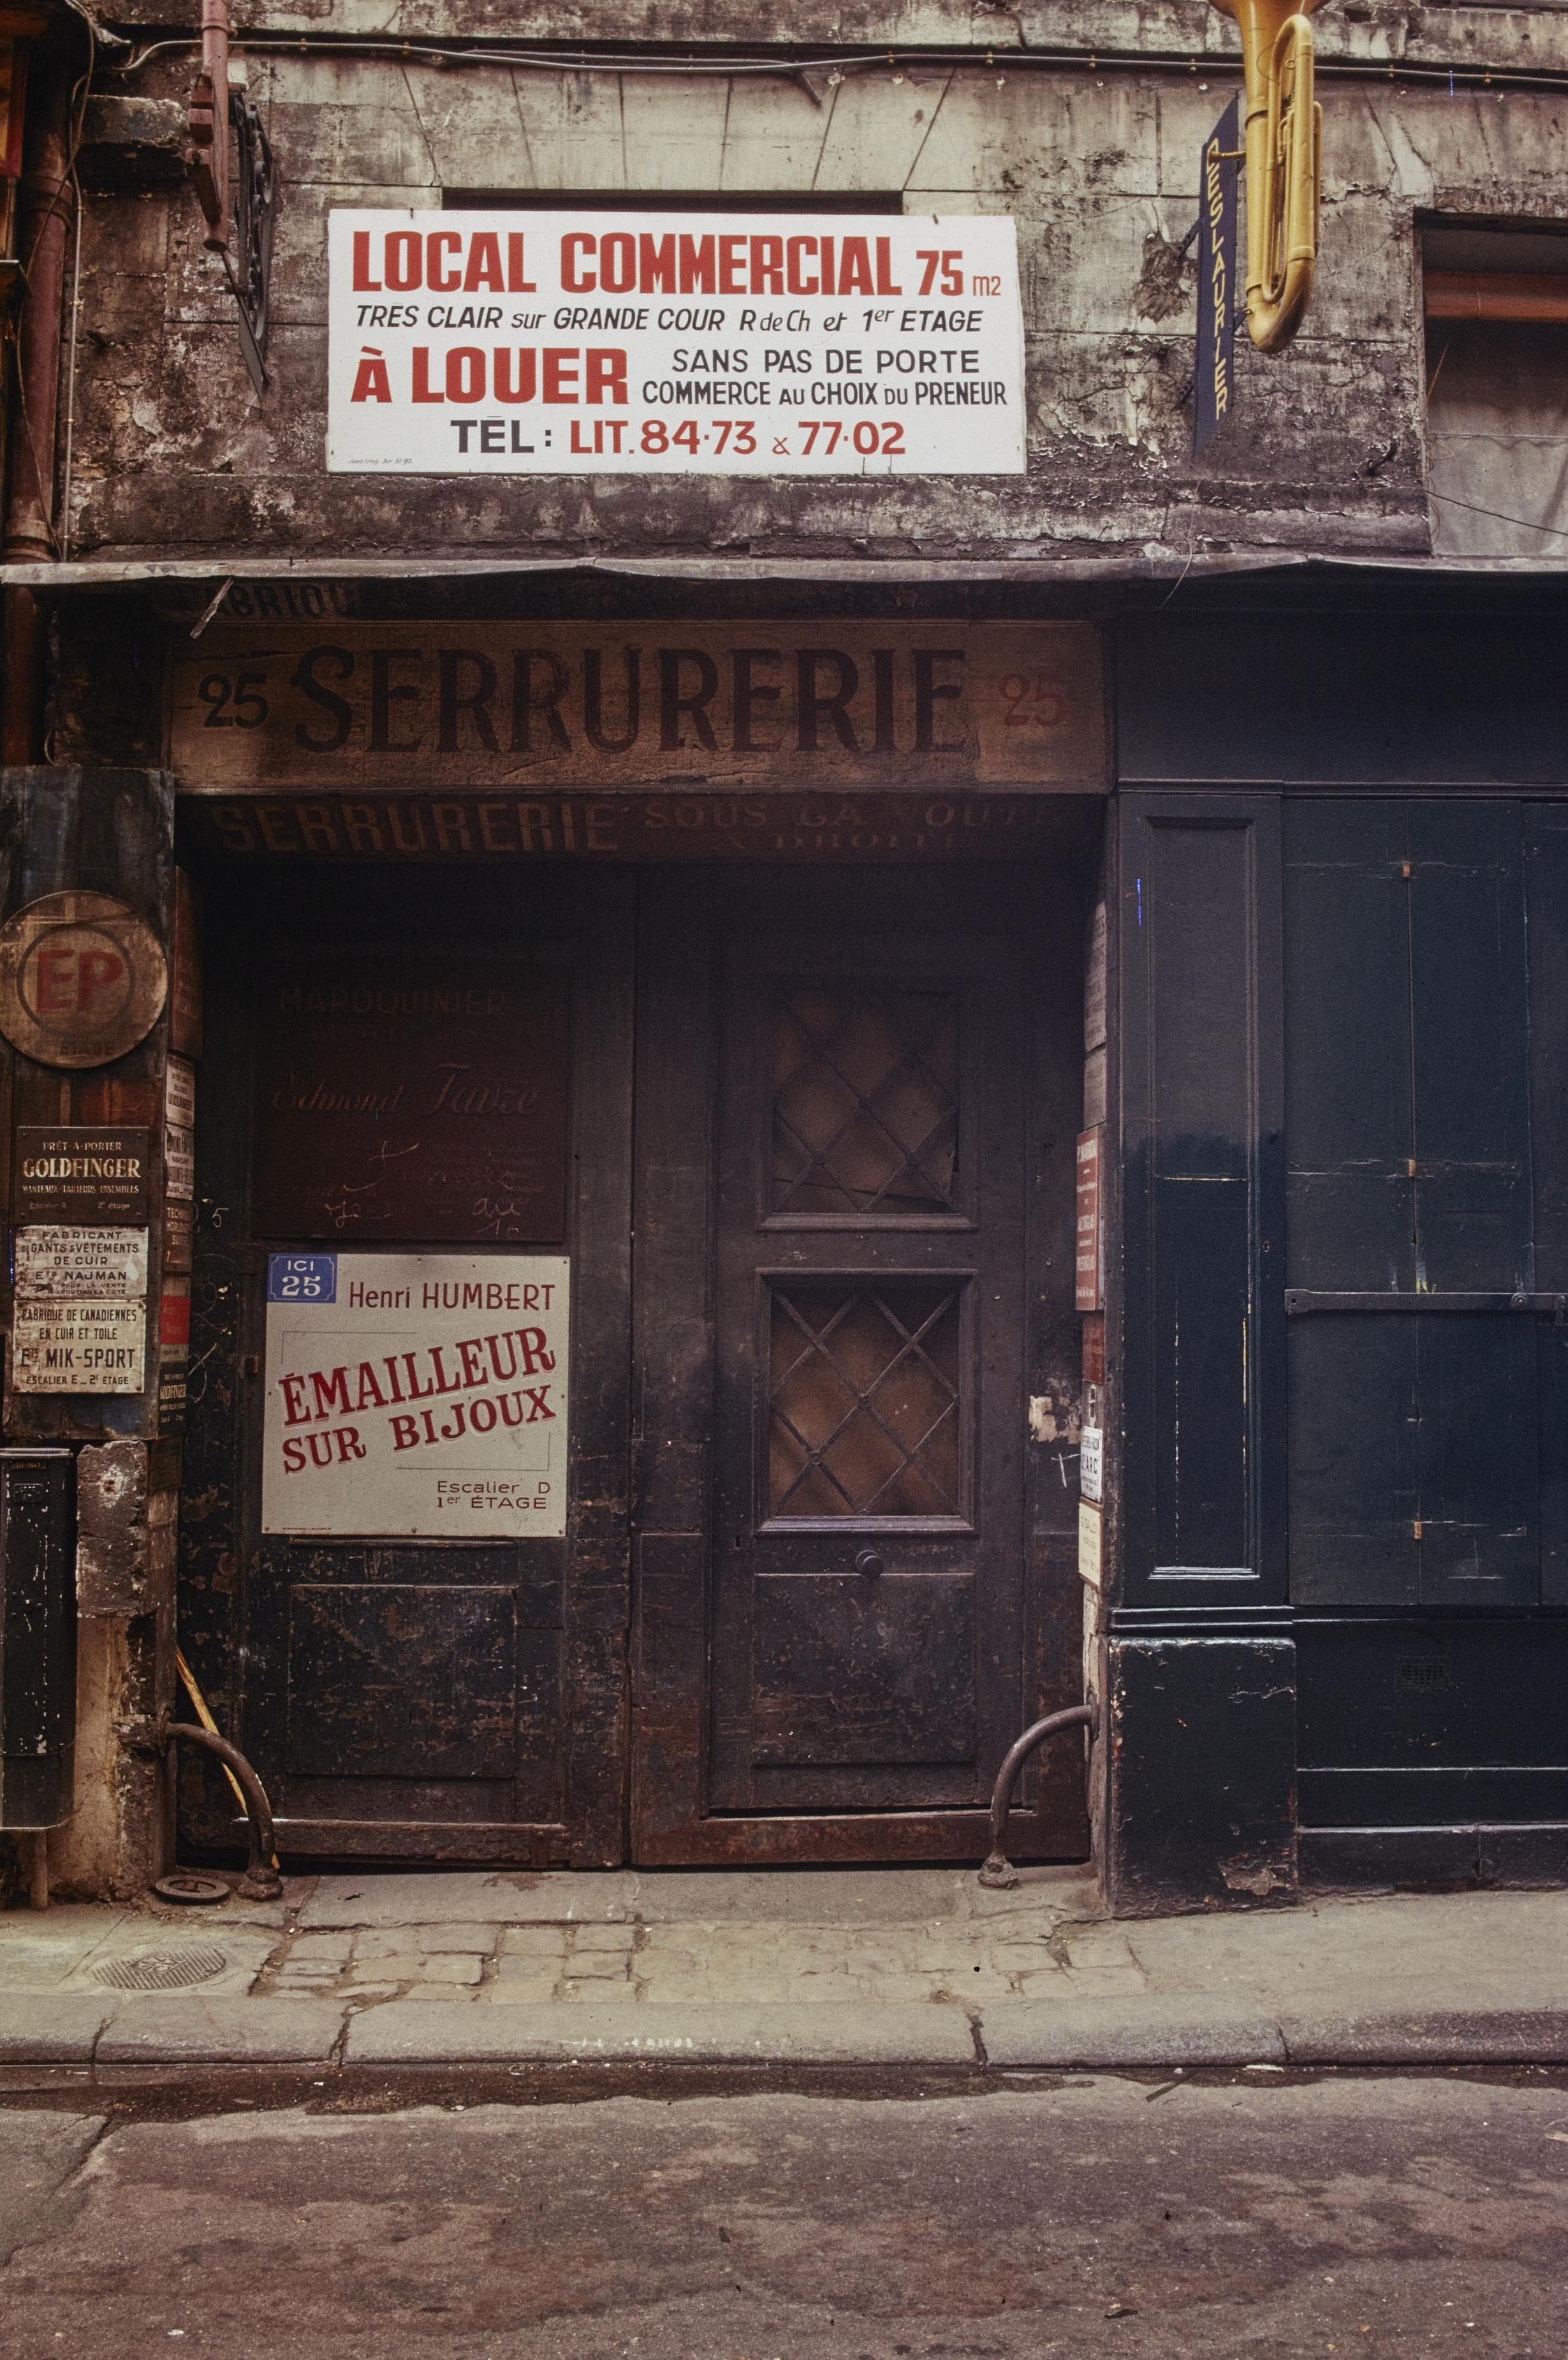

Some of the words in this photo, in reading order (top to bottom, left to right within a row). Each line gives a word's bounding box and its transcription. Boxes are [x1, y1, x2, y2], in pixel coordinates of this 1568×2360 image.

[353, 230, 537, 293] LOCAL
[561, 232, 903, 297] COMMERCIAL
[916, 249, 964, 297] 75
[427, 306, 503, 329] CLAIR
[511, 311, 547, 330] sur
[553, 307, 650, 330] GRANDE
[657, 308, 725, 331] COUR
[823, 311, 847, 332] et
[900, 310, 984, 332] ETAGE
[672, 349, 749, 373] SANS
[765, 350, 812, 374] PAS
[826, 350, 863, 374] DE
[877, 350, 979, 374] PORTE
[351, 346, 393, 403] À
[412, 346, 630, 404] LOUER
[643, 380, 770, 406] COMMERCE
[779, 388, 805, 405] AU
[811, 381, 879, 405] CHOIX
[885, 388, 909, 405] DU
[916, 381, 1008, 406] PRENEUR
[198, 673, 269, 730] 25
[290, 645, 967, 754] SERRURERIE
[998, 672, 1067, 726] 25
[212, 802, 619, 852] SERRURERIE
[36, 948, 124, 1013] EP
[22, 1158, 141, 1178] GOLDFINGER
[43, 1231, 122, 1239] FABRICANT
[31, 1243, 67, 1253] GANTS
[54, 1257, 70, 1265] DE
[75, 1256, 108, 1265] CUIR
[286, 1260, 314, 1271] ICI
[65, 1271, 127, 1280] NAJMAN
[282, 1276, 321, 1296] 25
[349, 1281, 410, 1309] Henri
[423, 1283, 555, 1311] HUMBERT
[22, 1309, 63, 1322] FABRIQUE
[67, 1309, 77, 1322] DE
[80, 1309, 137, 1322] CANADIENNES
[40, 1327, 51, 1340] EN
[55, 1327, 74, 1340] CUIR
[78, 1327, 89, 1340] ET
[94, 1327, 117, 1340] TOILE
[46, 1348, 135, 1368] MIK-SPORT
[27, 1376, 68, 1385] ESCALIER
[71, 1375, 78, 1385] E
[278, 1326, 557, 1427] ÉMAILLEUR
[282, 1426, 367, 1474] SUR
[388, 1385, 557, 1452] BIJOUX
[437, 1480, 519, 1494] Escalier
[538, 1482, 550, 1494] D
[471, 1494, 547, 1510] ÉTAGE
